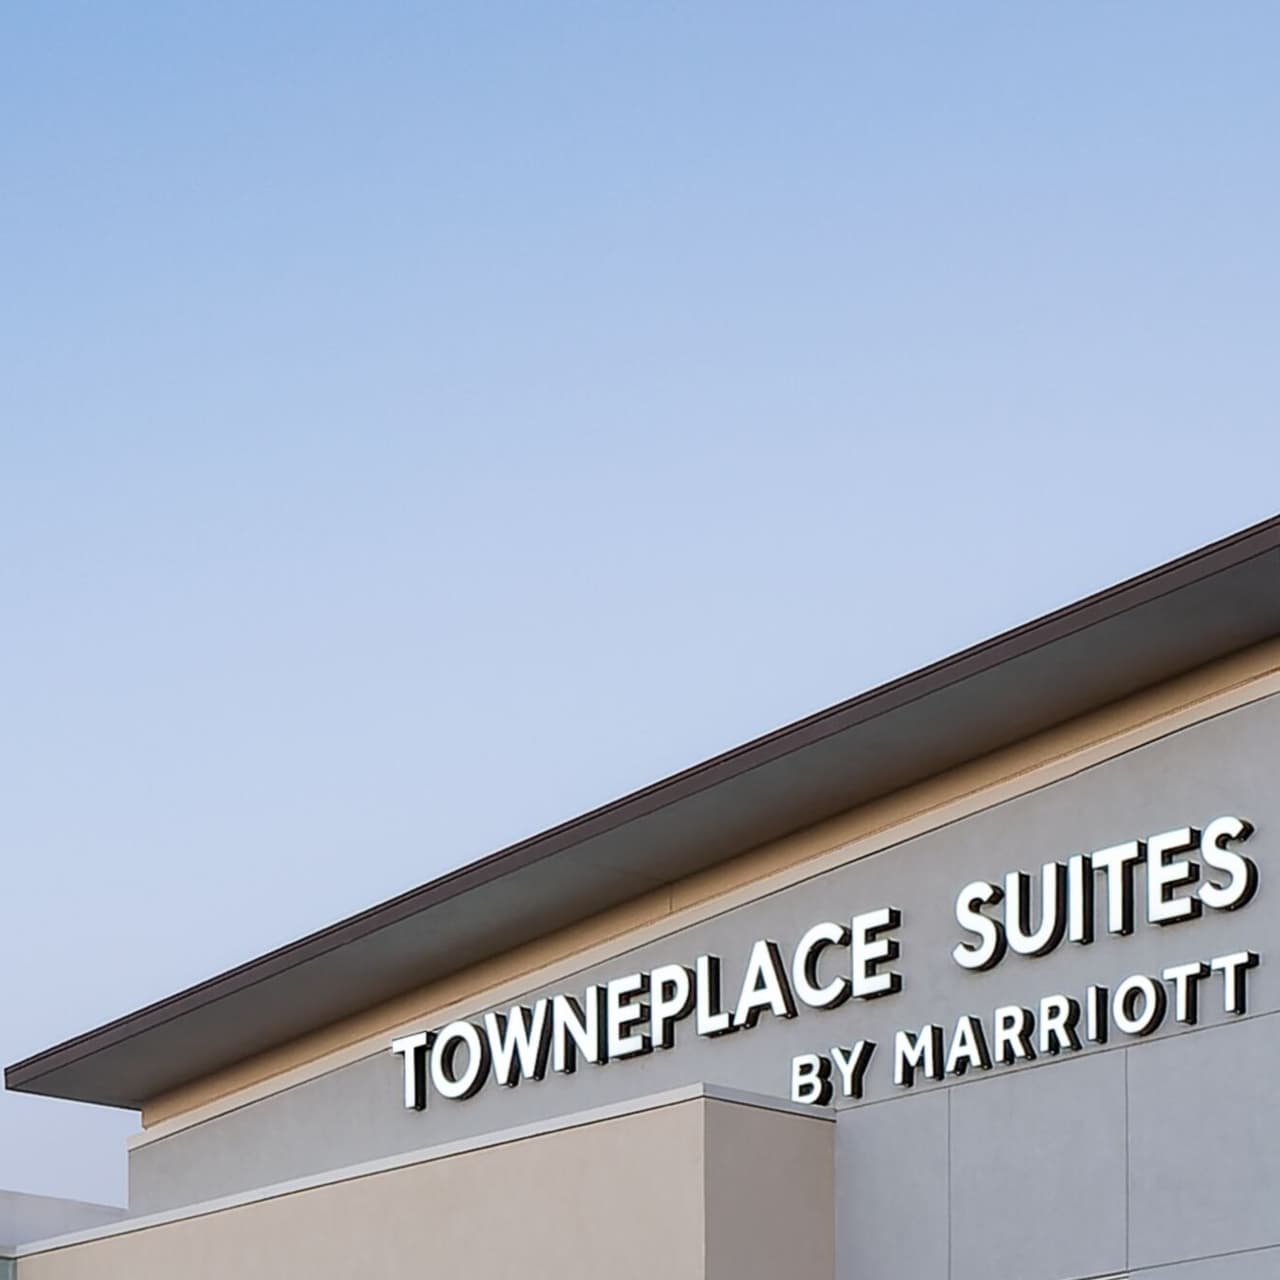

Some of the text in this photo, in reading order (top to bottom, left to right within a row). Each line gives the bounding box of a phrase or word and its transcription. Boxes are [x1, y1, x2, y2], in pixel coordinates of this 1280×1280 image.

[392, 816, 1258, 1111] TOWNEPLACE SUITES
[791, 950, 1259, 1106] BY MARRIOTT
